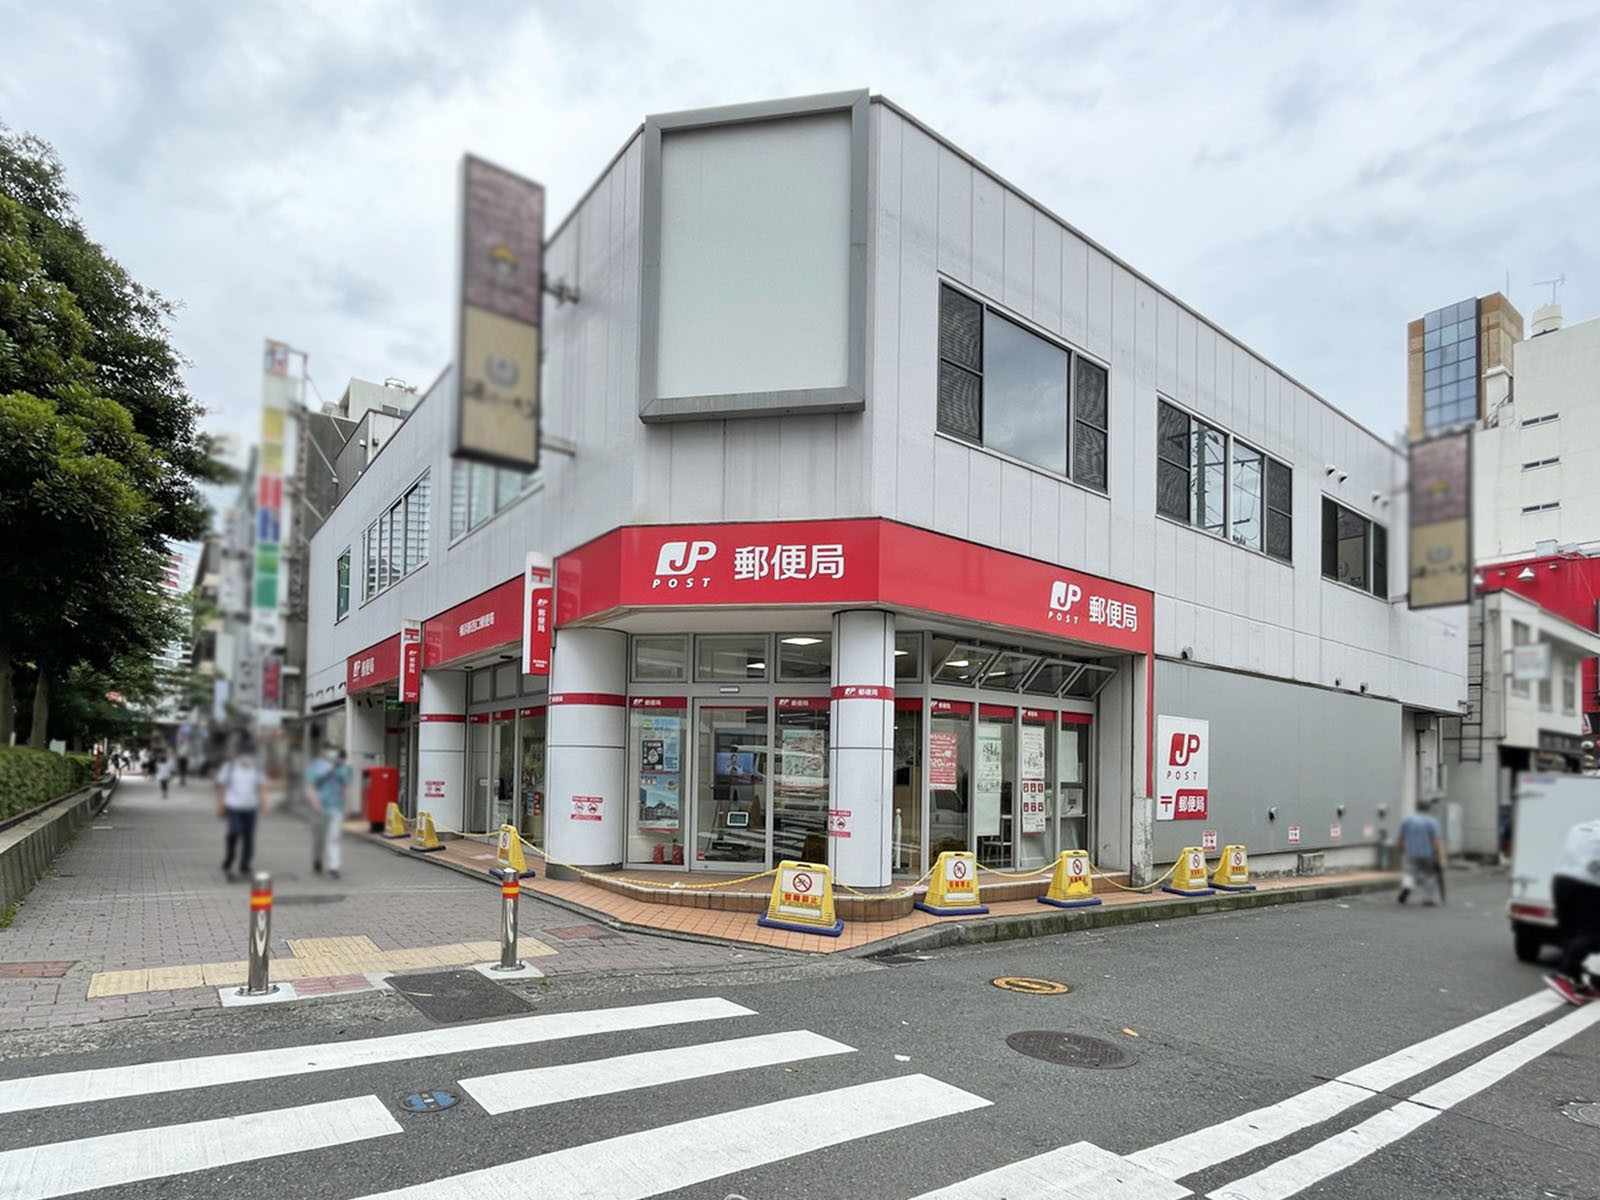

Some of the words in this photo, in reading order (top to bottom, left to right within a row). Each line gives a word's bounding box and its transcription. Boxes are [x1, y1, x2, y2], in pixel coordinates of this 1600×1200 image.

[655, 541, 717, 576] JP
[734, 544, 845, 581] 郵便局
[652, 577, 711, 589] POST
[1049, 580, 1082, 611] JP
[1089, 595, 1138, 632] 郵便局
[1048, 610, 1079, 625] POST
[1169, 732, 1201, 767] JP
[1166, 770, 1198, 781] POST
[1178, 795, 1205, 813] 郵便局
